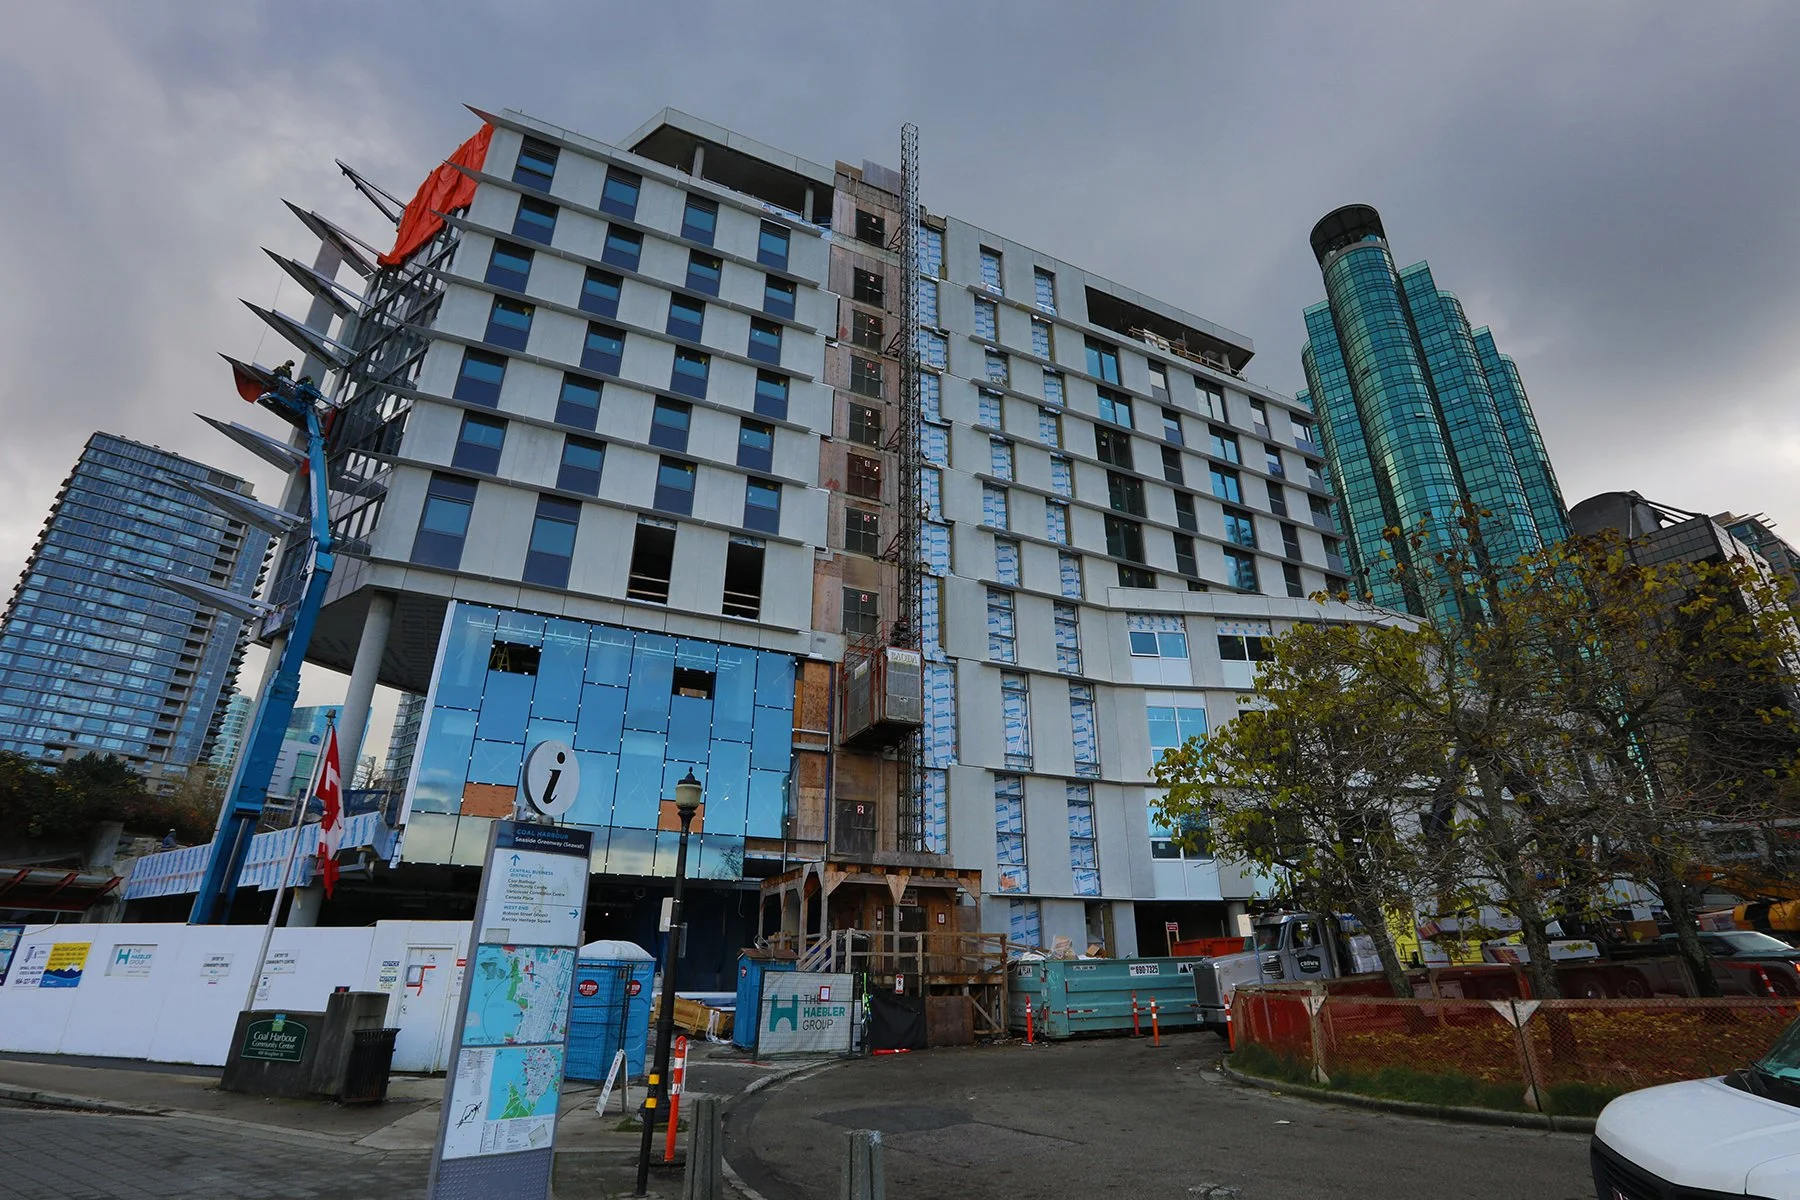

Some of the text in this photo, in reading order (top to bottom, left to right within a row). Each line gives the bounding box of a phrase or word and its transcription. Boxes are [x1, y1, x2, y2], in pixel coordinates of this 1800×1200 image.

[543, 751, 566, 804] i
[516, 828, 569, 840] COAL HARBOUR
[515, 836, 536, 844] Seaside
[537, 838, 562, 848] Greenway
[803, 1006, 846, 1018] HAEBLER
[802, 1019, 834, 1031] GROUP
[253, 1031, 297, 1043] Coal Harbour
[251, 1040, 277, 1050] Community
